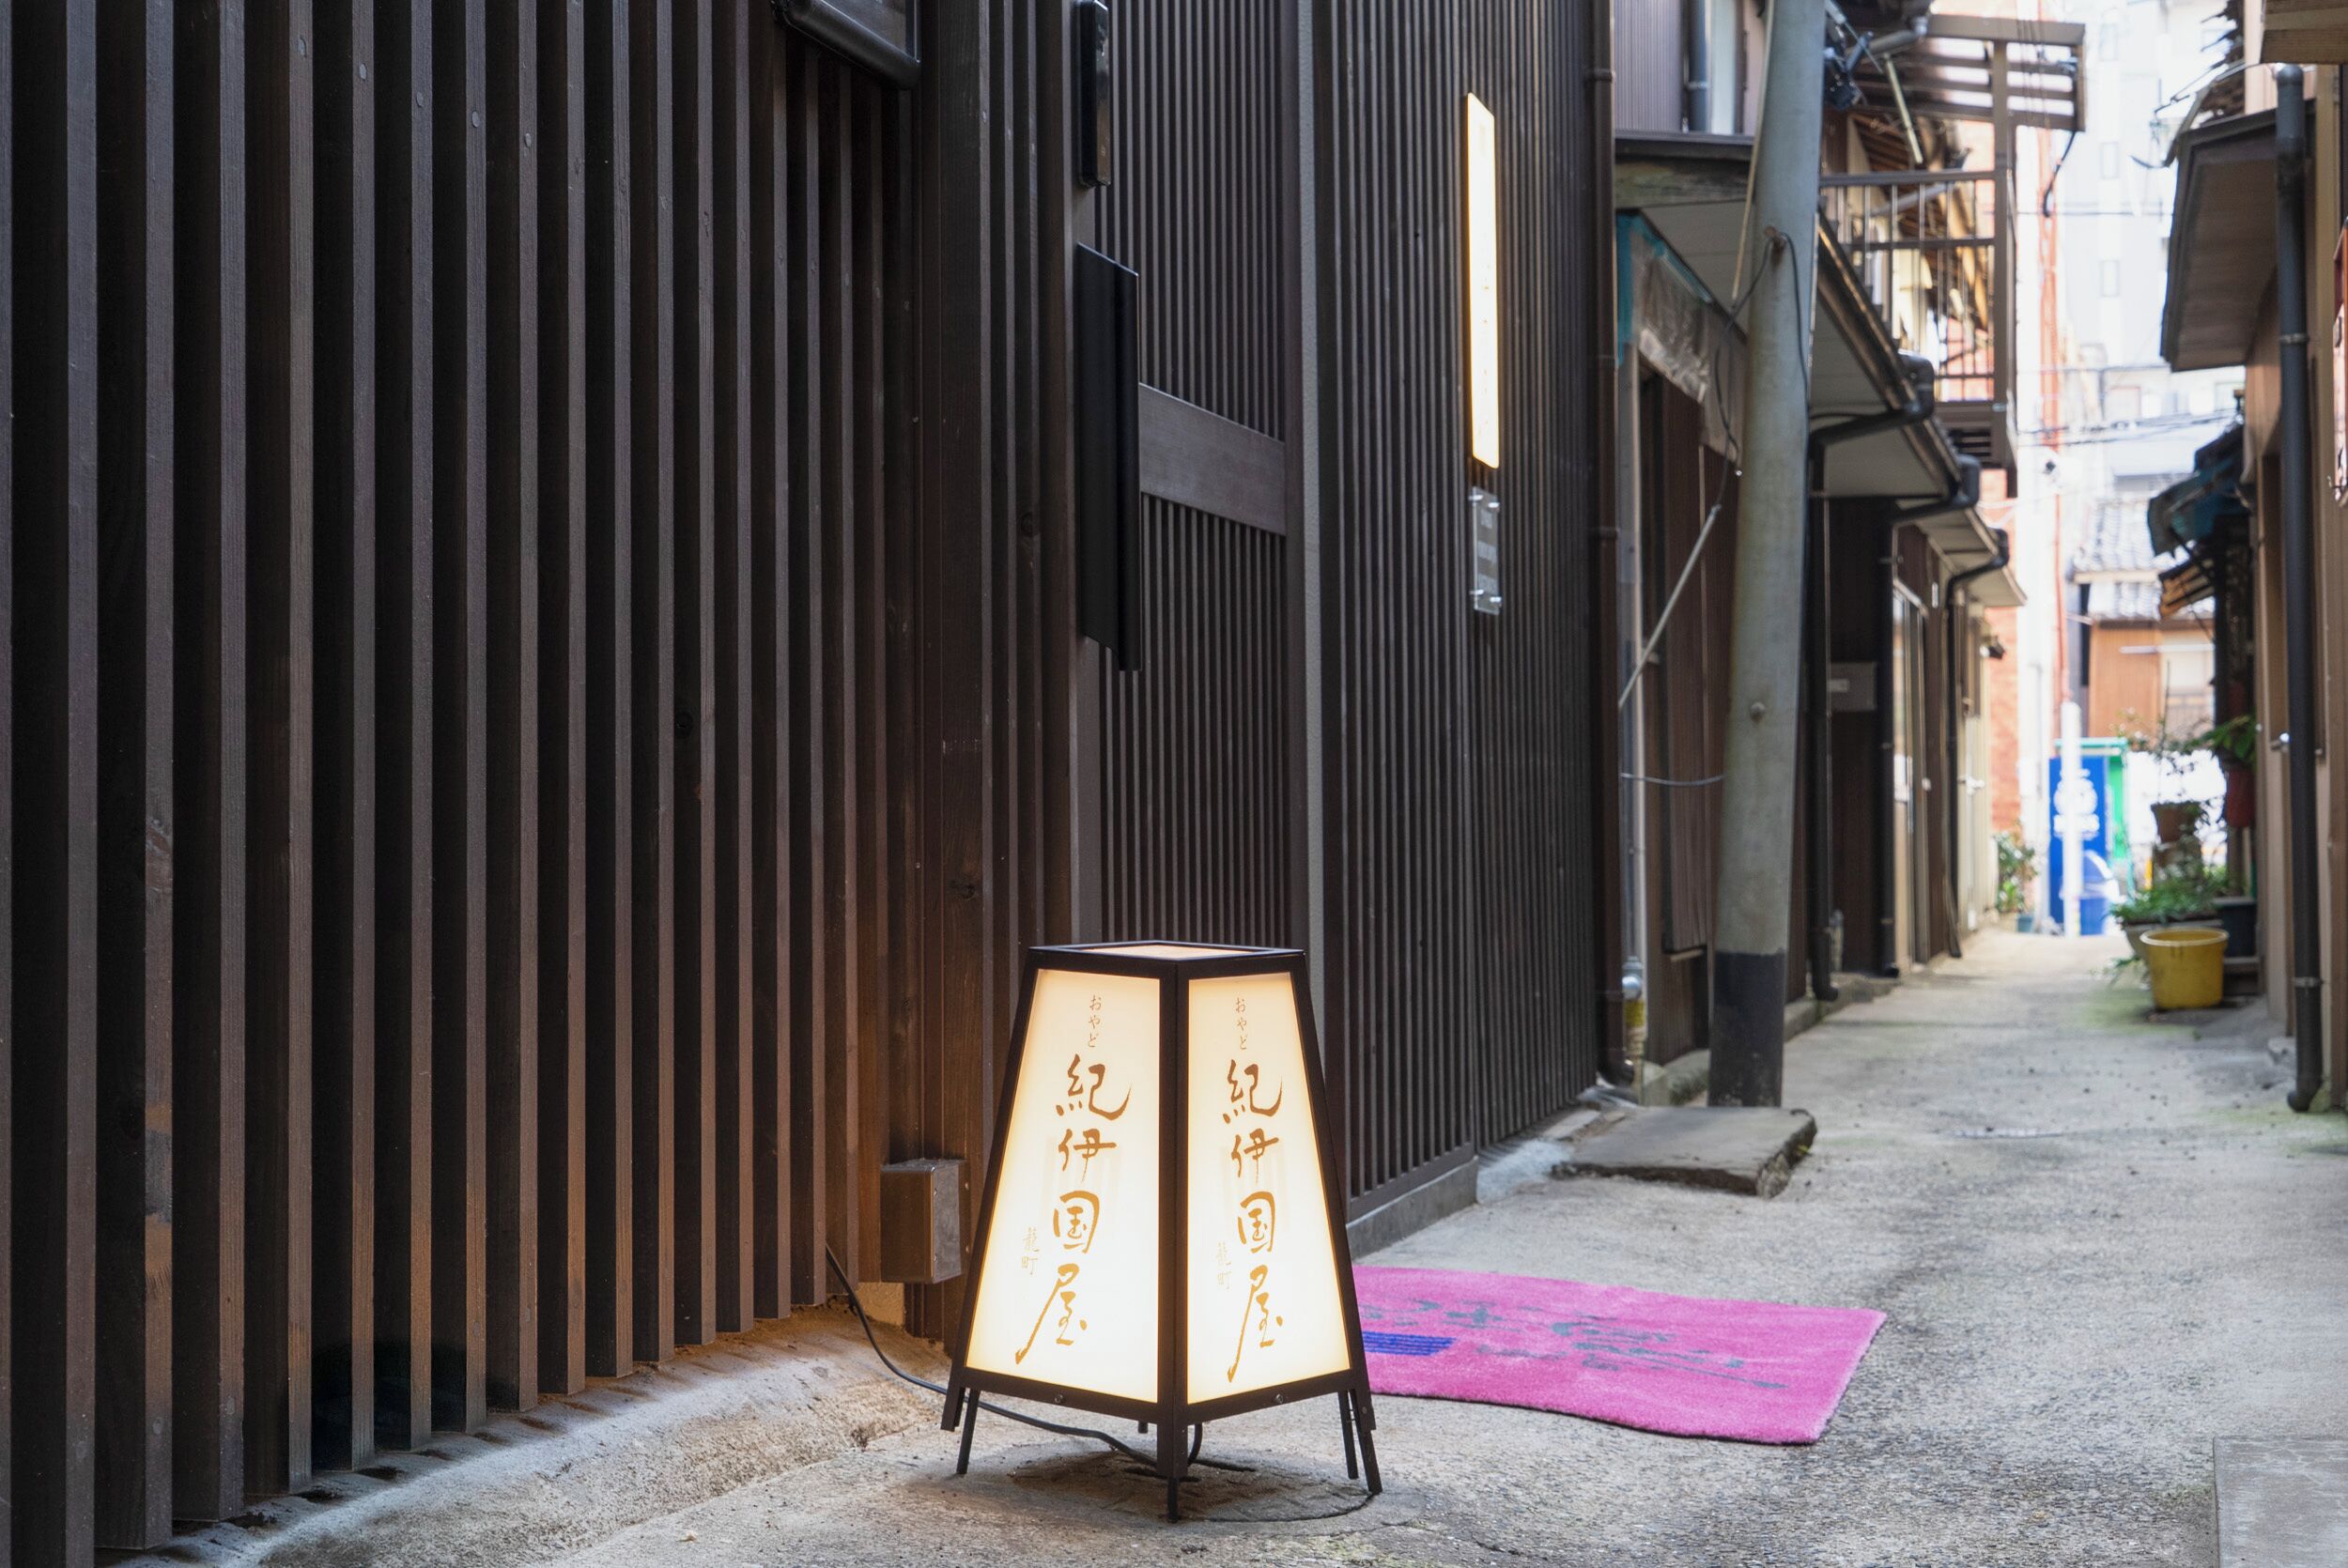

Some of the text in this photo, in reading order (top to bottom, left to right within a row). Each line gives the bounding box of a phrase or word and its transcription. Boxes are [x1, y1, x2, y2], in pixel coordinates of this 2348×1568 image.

[1088, 994, 1102, 1049] おやど
[1235, 996, 1248, 1051] おやど
[1015, 1053, 1132, 1365] 紀伊国屋
[1221, 1058, 1284, 1383] 紀伊国屋
